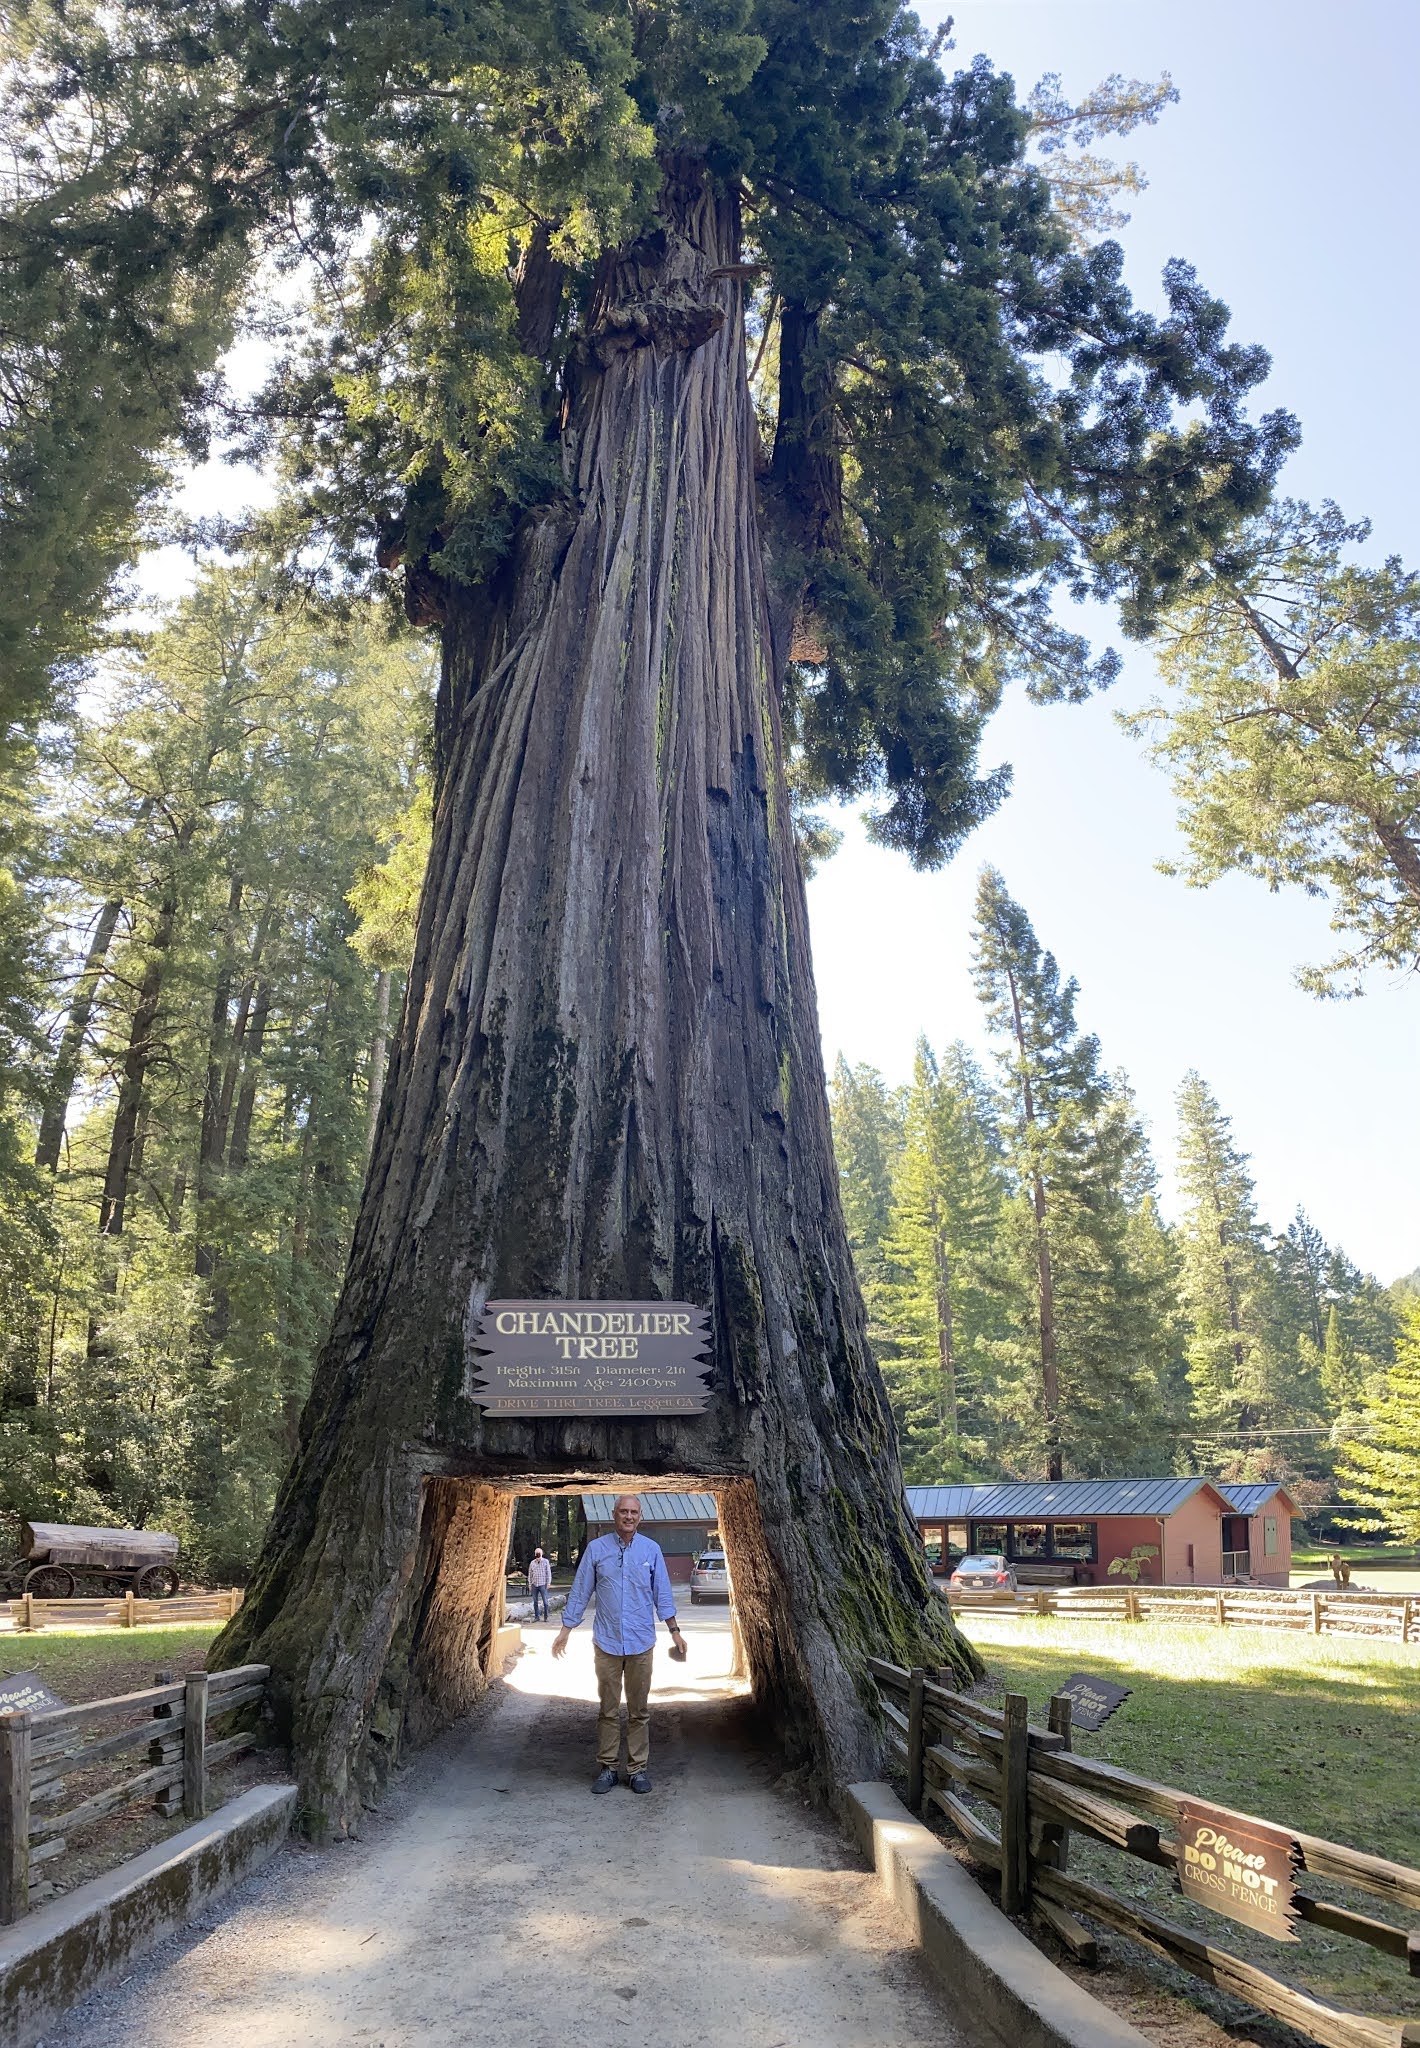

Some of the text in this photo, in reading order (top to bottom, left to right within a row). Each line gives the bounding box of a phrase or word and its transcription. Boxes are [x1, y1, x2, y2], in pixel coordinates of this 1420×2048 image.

[496, 1312, 693, 1335] CHANDELIER
[556, 1337, 639, 1359] TREE
[595, 1366, 660, 1375] Diameter:
[508, 1379, 577, 1388] Maximum
[584, 1378, 613, 1391] Age:
[497, 1399, 538, 1408] DRIVE
[0, 1687, 31, 1703] lease
[15, 1691, 45, 1708] NOT
[26, 1698, 54, 1712] FENCE
[1076, 1706, 1100, 1720] FENCE
[1078, 1698, 1107, 1712] NOT
[1195, 1827, 1267, 1870] Please
[1184, 1844, 1278, 1896] DO NOT
[1184, 1863, 1278, 1915] CROSS FENCE
